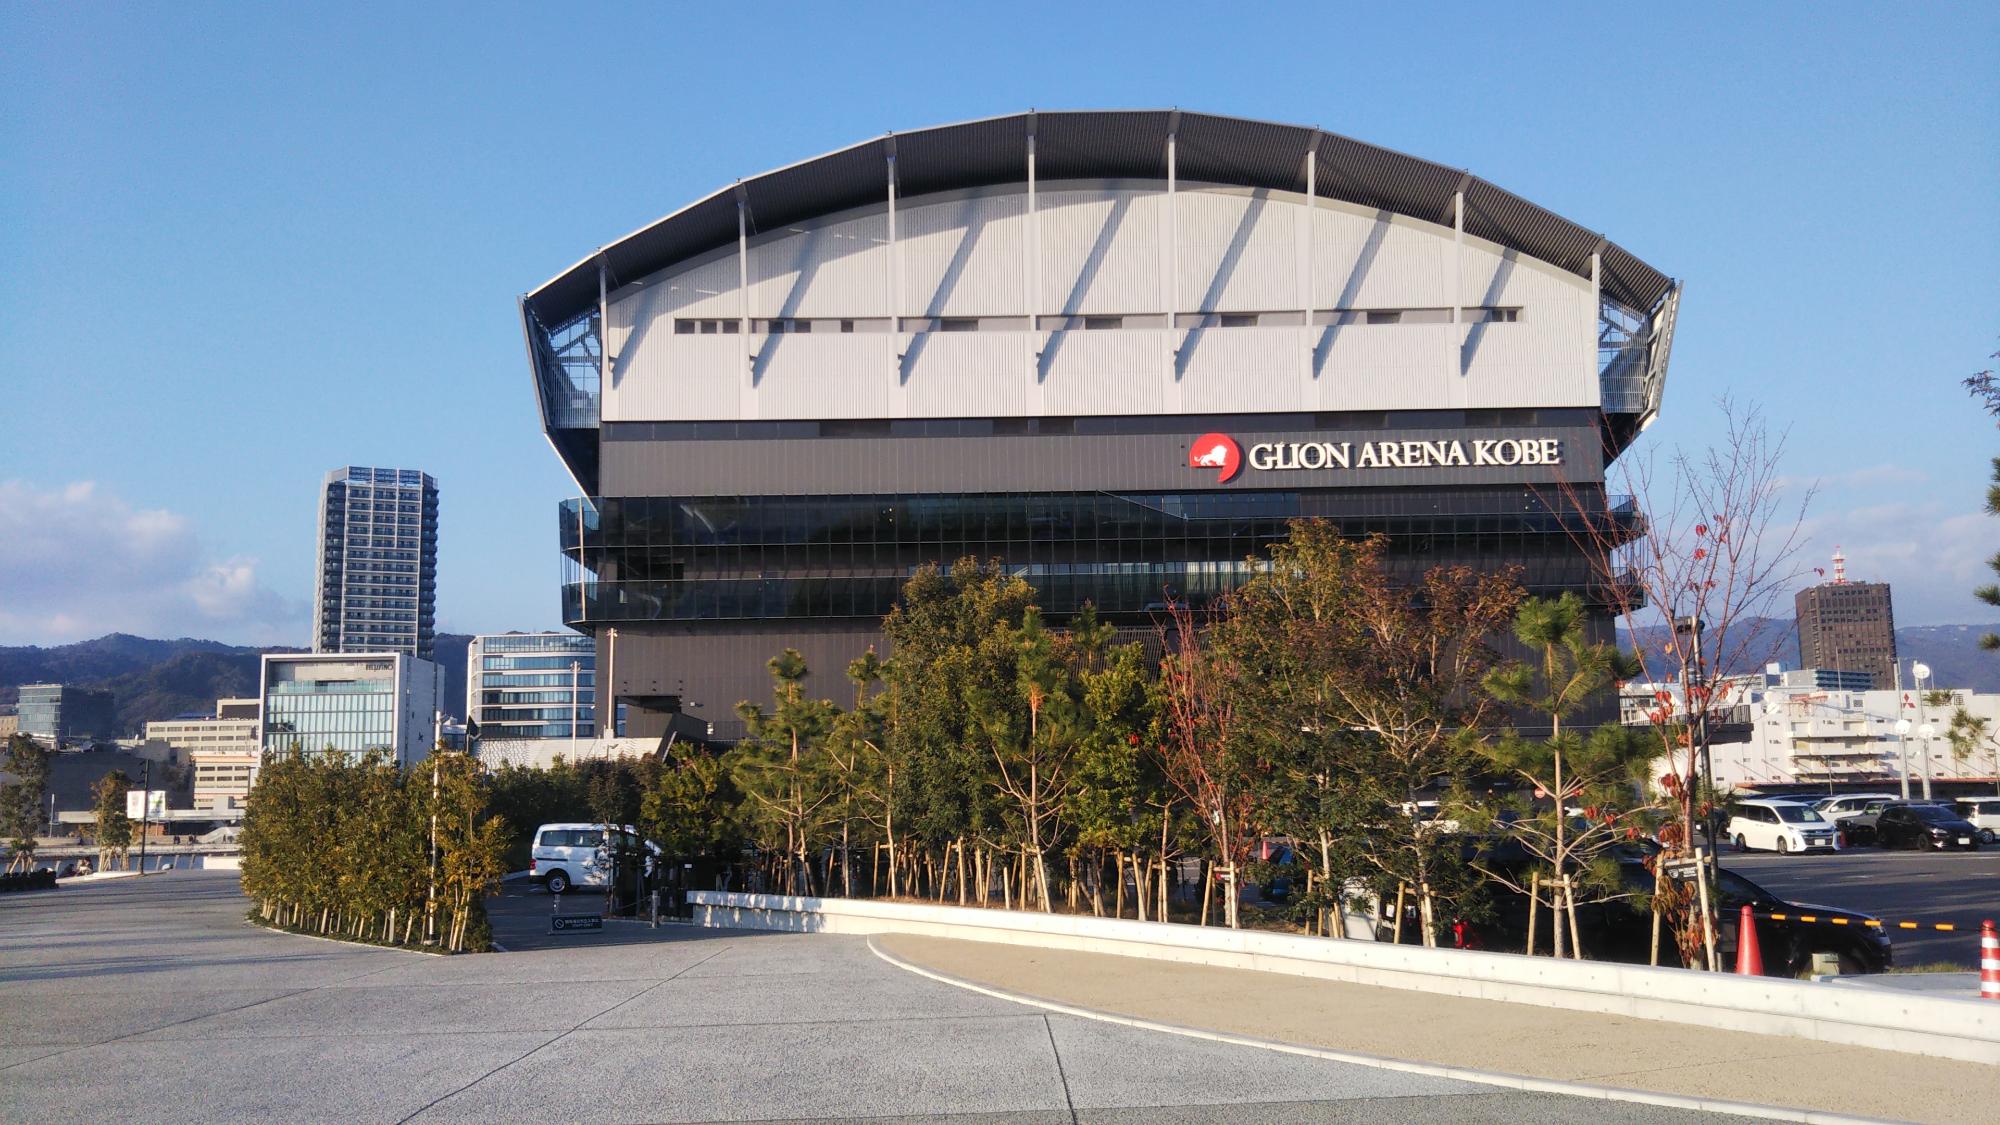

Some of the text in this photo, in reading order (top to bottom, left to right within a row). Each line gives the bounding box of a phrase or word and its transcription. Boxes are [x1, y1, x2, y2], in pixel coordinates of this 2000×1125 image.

[1248, 438, 1561, 470] GLION ARENA KOBE
